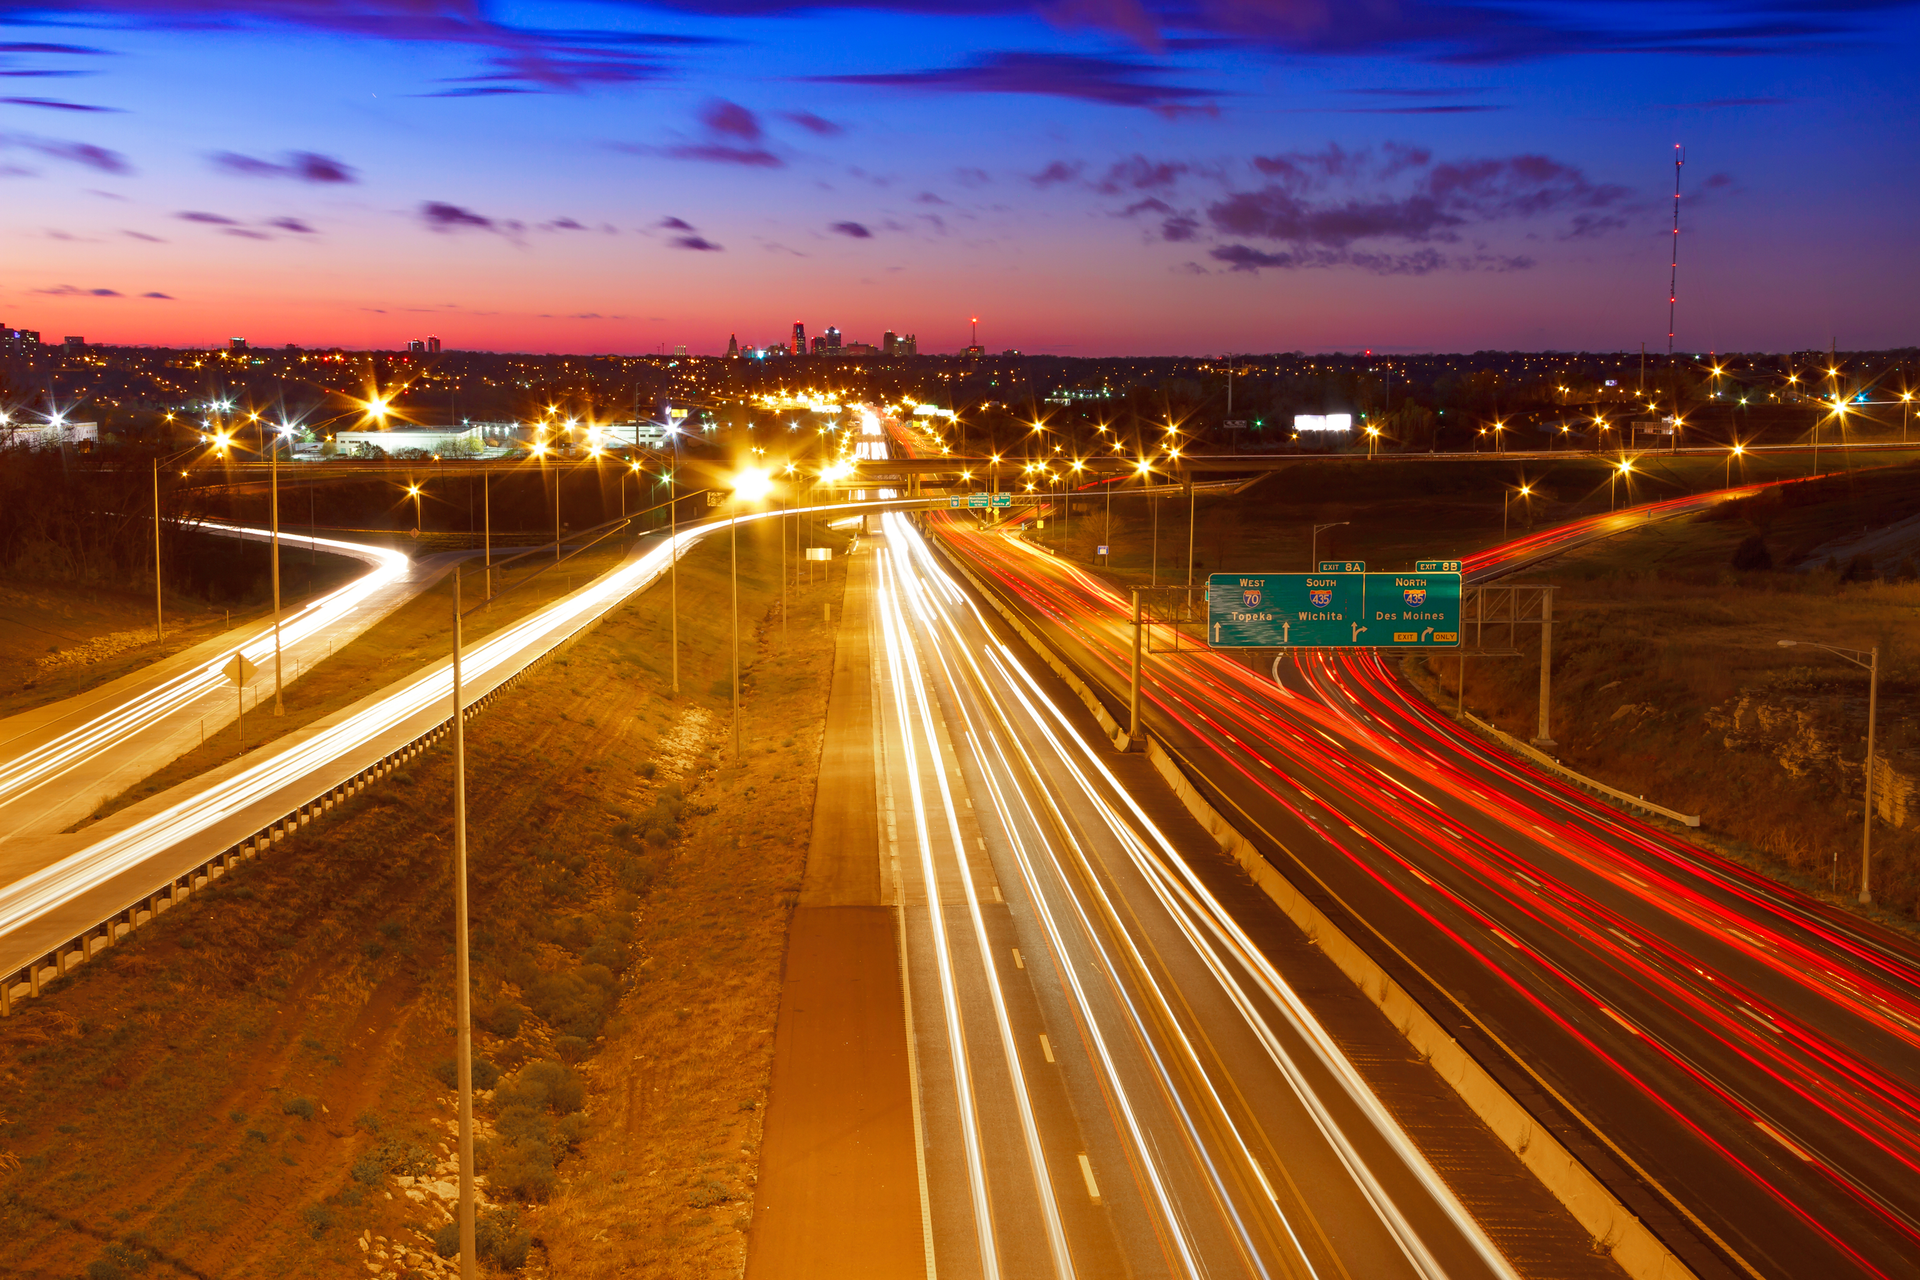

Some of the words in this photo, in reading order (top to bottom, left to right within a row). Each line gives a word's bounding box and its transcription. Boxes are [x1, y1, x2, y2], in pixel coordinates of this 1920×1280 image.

[1345, 563, 1361, 572] 8A
[1442, 562, 1458, 571] 8B
[1239, 578, 1265, 587] WEST
[1306, 578, 1337, 587] SOUTH
[1395, 577, 1427, 587] NORTH
[1245, 594, 1259, 605] 70
[1312, 594, 1330, 605] 435
[1406, 593, 1424, 604] 435
[1231, 611, 1272, 623] Topeka
[1298, 611, 1343, 621] Wichita
[1376, 611, 1397, 621] Des
[1403, 611, 1445, 620] Moines
